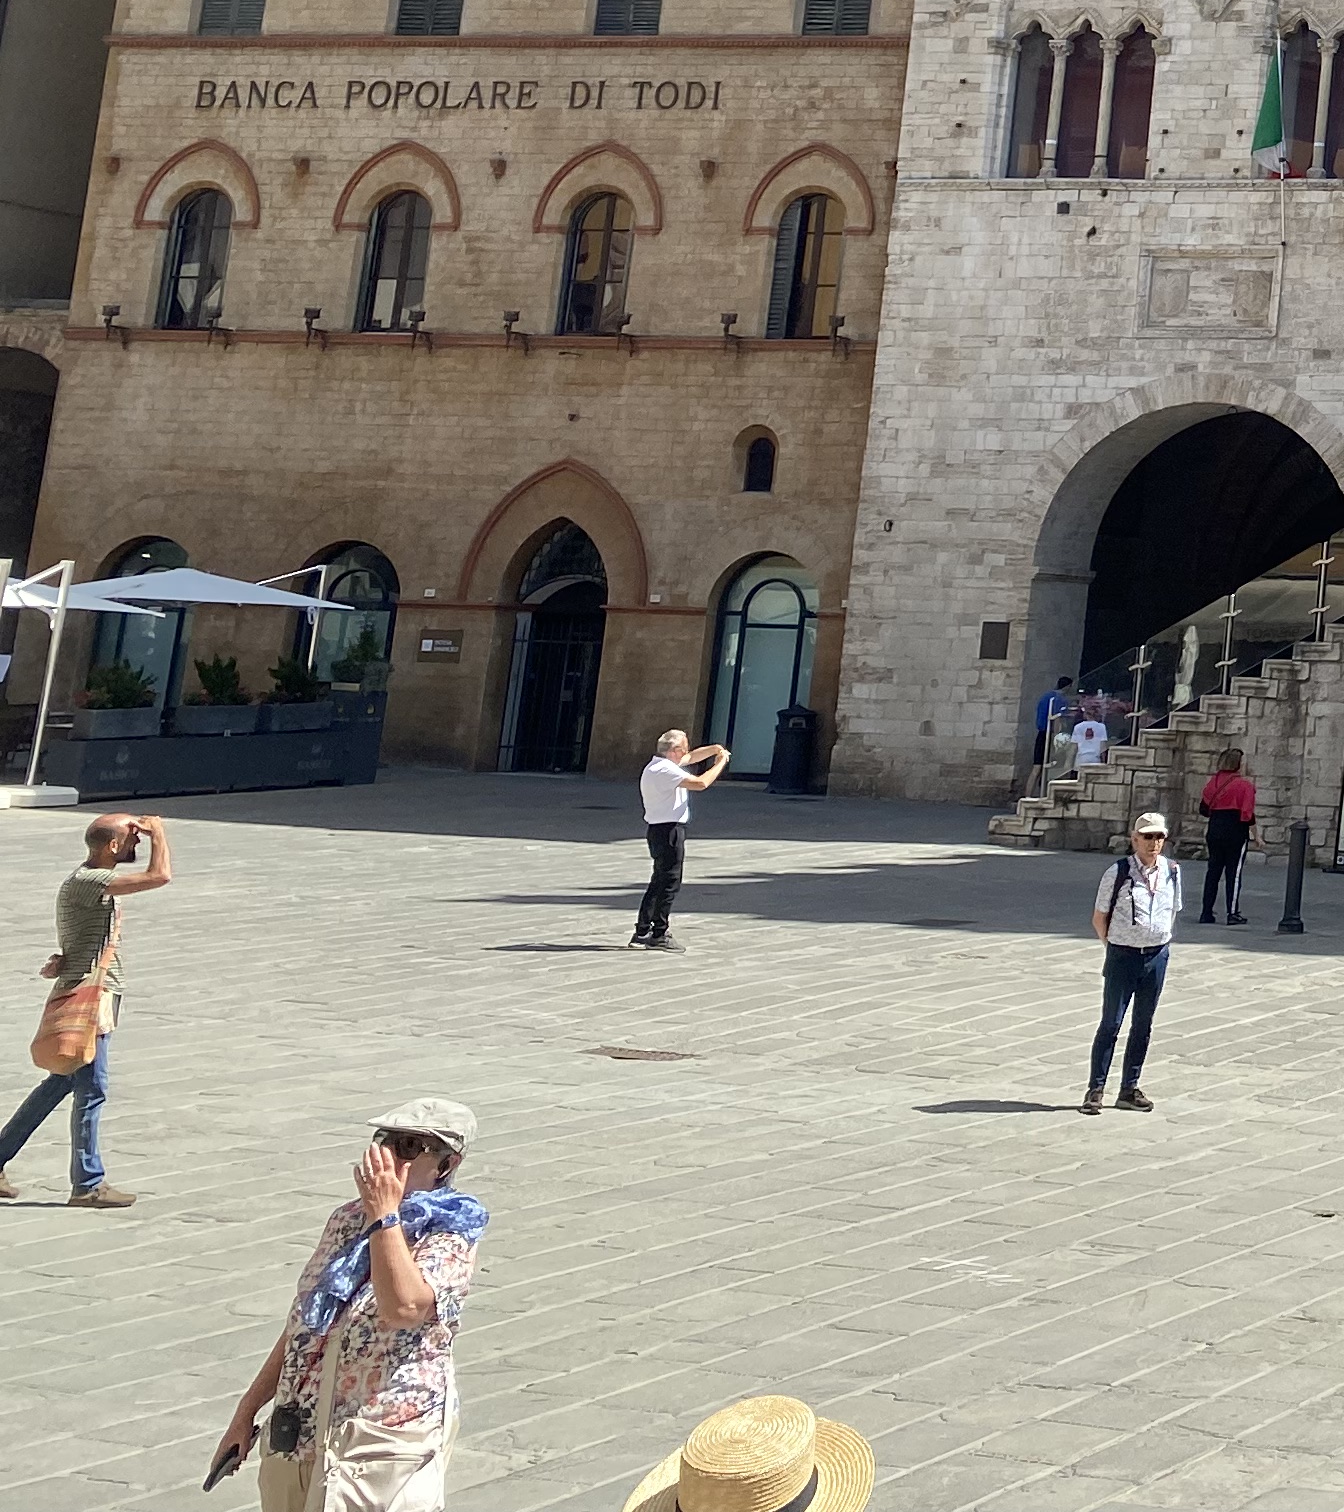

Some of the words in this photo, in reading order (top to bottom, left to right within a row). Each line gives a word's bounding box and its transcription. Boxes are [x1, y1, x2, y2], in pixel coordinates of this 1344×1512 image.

[195, 79, 320, 110] BANCA
[344, 79, 539, 110] POPOLARE
[568, 79, 609, 110] DI
[632, 79, 722, 111] TODI
